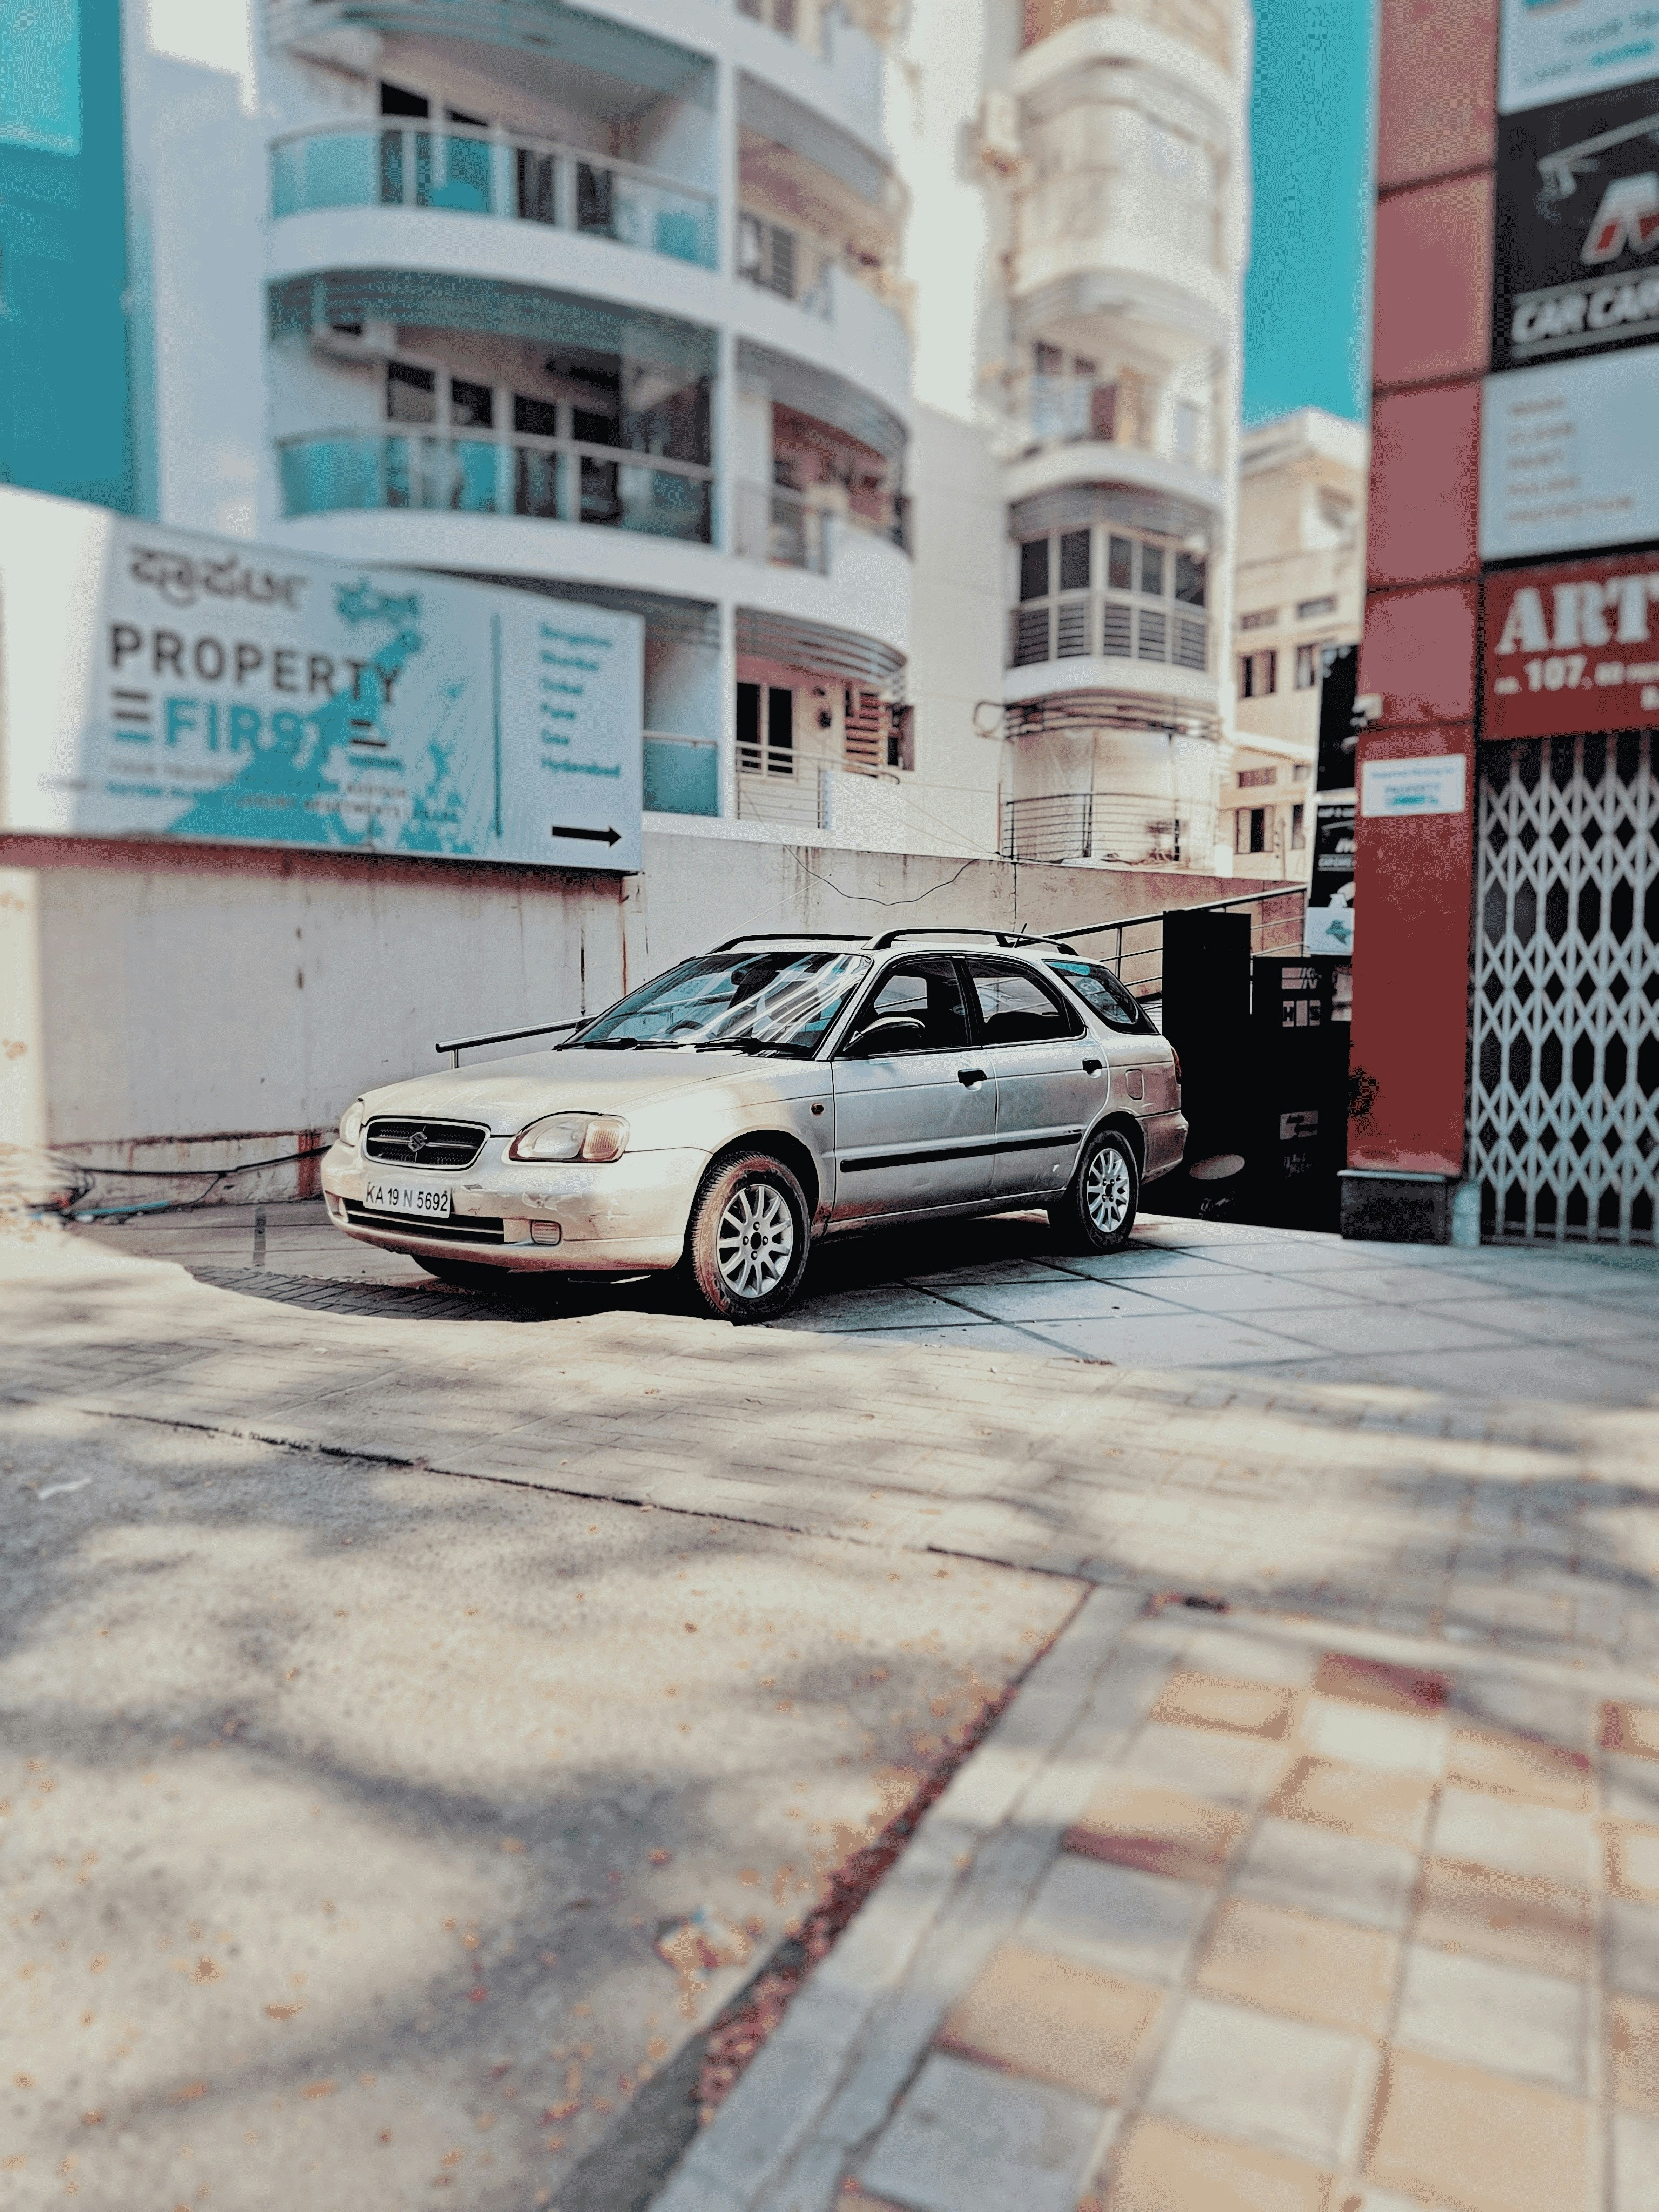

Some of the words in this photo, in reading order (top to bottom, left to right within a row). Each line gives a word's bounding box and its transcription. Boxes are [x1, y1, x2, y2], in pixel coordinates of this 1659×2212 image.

[1511, 294, 1587, 345] CAR
[111, 622, 401, 705] PROPERTY
[165, 698, 336, 763] FIRST
[540, 755, 621, 779] Hyderabad
[366, 1185, 384, 1204] KA
[388, 1188, 399, 1206] 19
[403, 1189, 413, 1208] N
[417, 1191, 449, 1212] 5692
